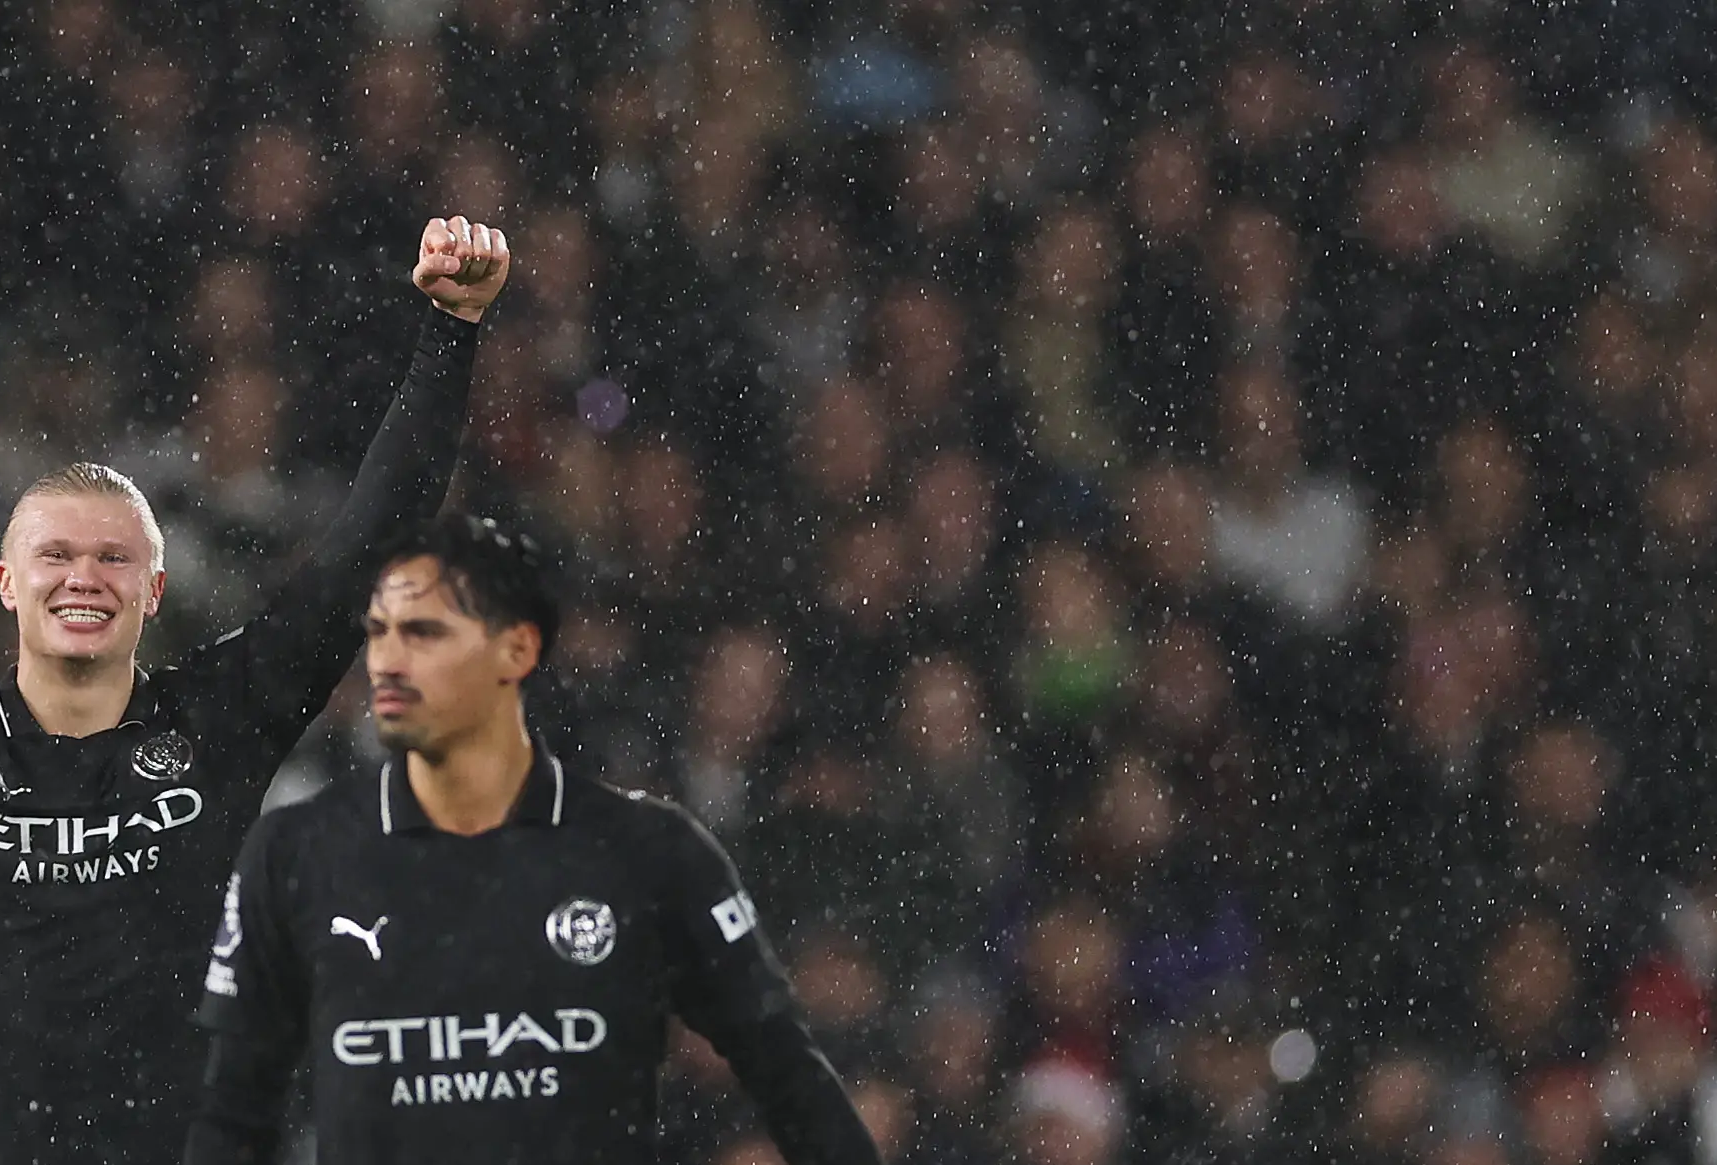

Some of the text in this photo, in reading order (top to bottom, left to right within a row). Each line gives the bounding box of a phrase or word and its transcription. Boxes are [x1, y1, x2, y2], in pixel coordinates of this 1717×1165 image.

[11, 845, 160, 884] AIRWAYS
[332, 1008, 607, 1065] ETIHAD
[391, 1066, 559, 1106] AIRWAYS
